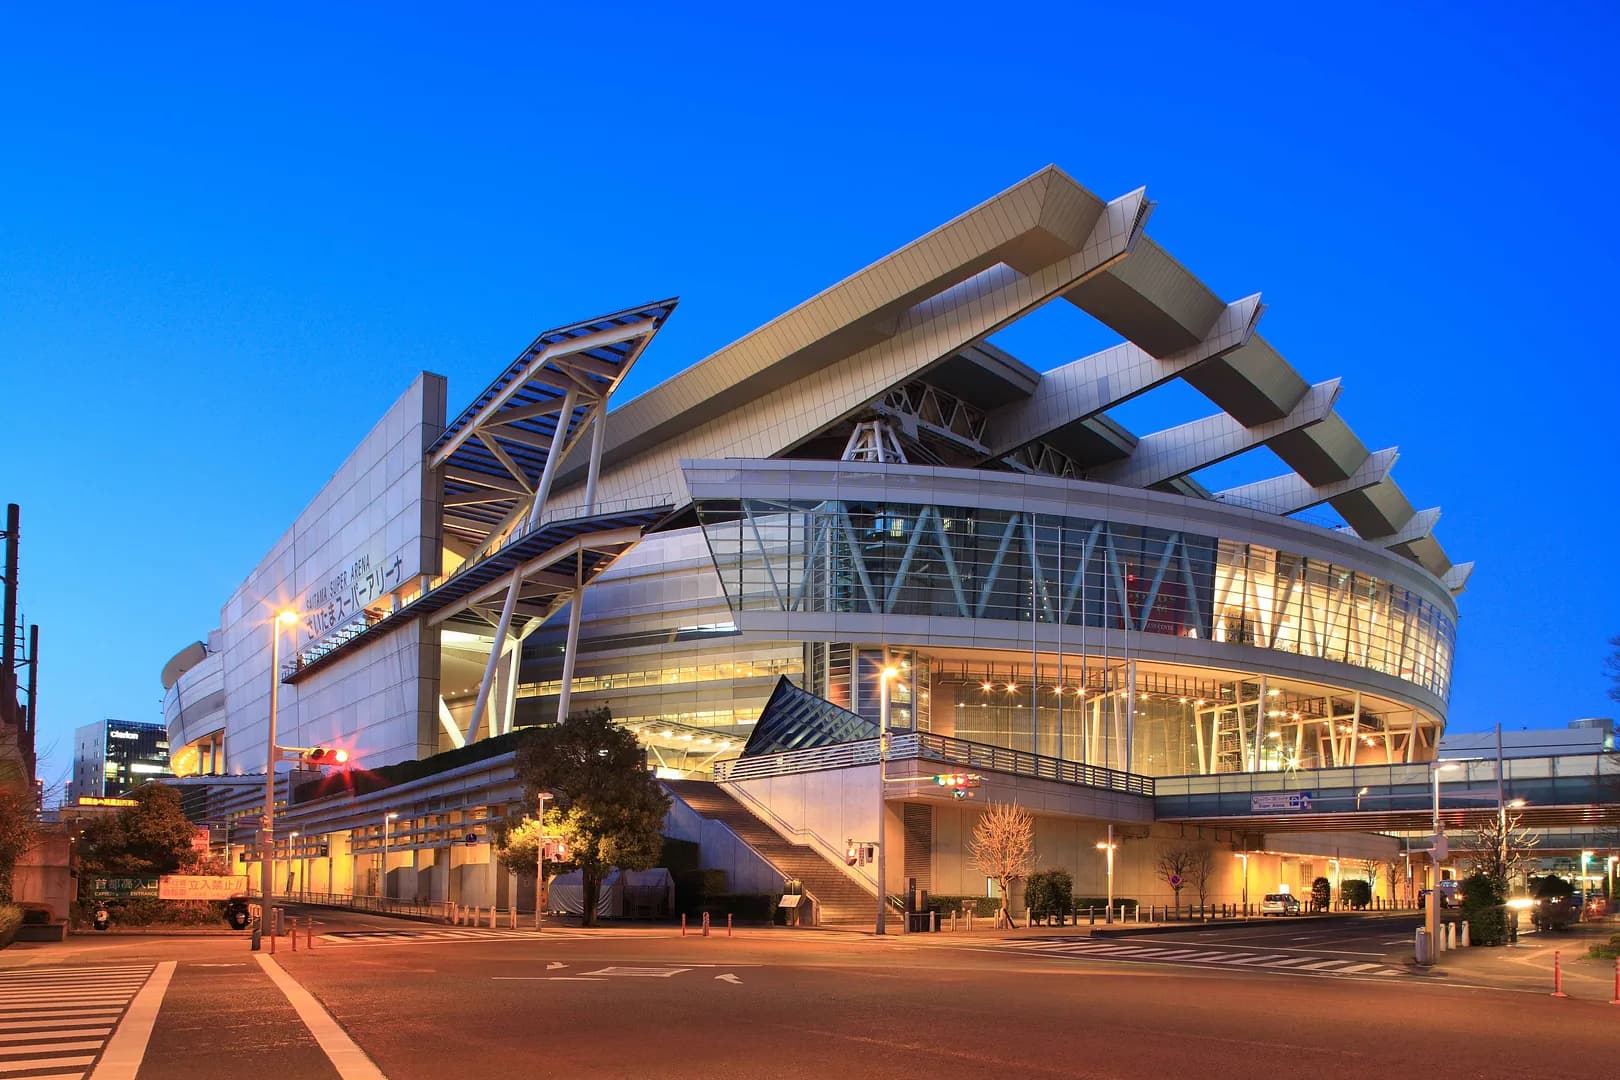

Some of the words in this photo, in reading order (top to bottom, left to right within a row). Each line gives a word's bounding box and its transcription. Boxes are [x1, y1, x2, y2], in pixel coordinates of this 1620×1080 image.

[306, 554, 402, 640] さいたまスーパーアリーナ
[329, 570, 348, 597] SUPER
[350, 553, 370, 582] ARENA
